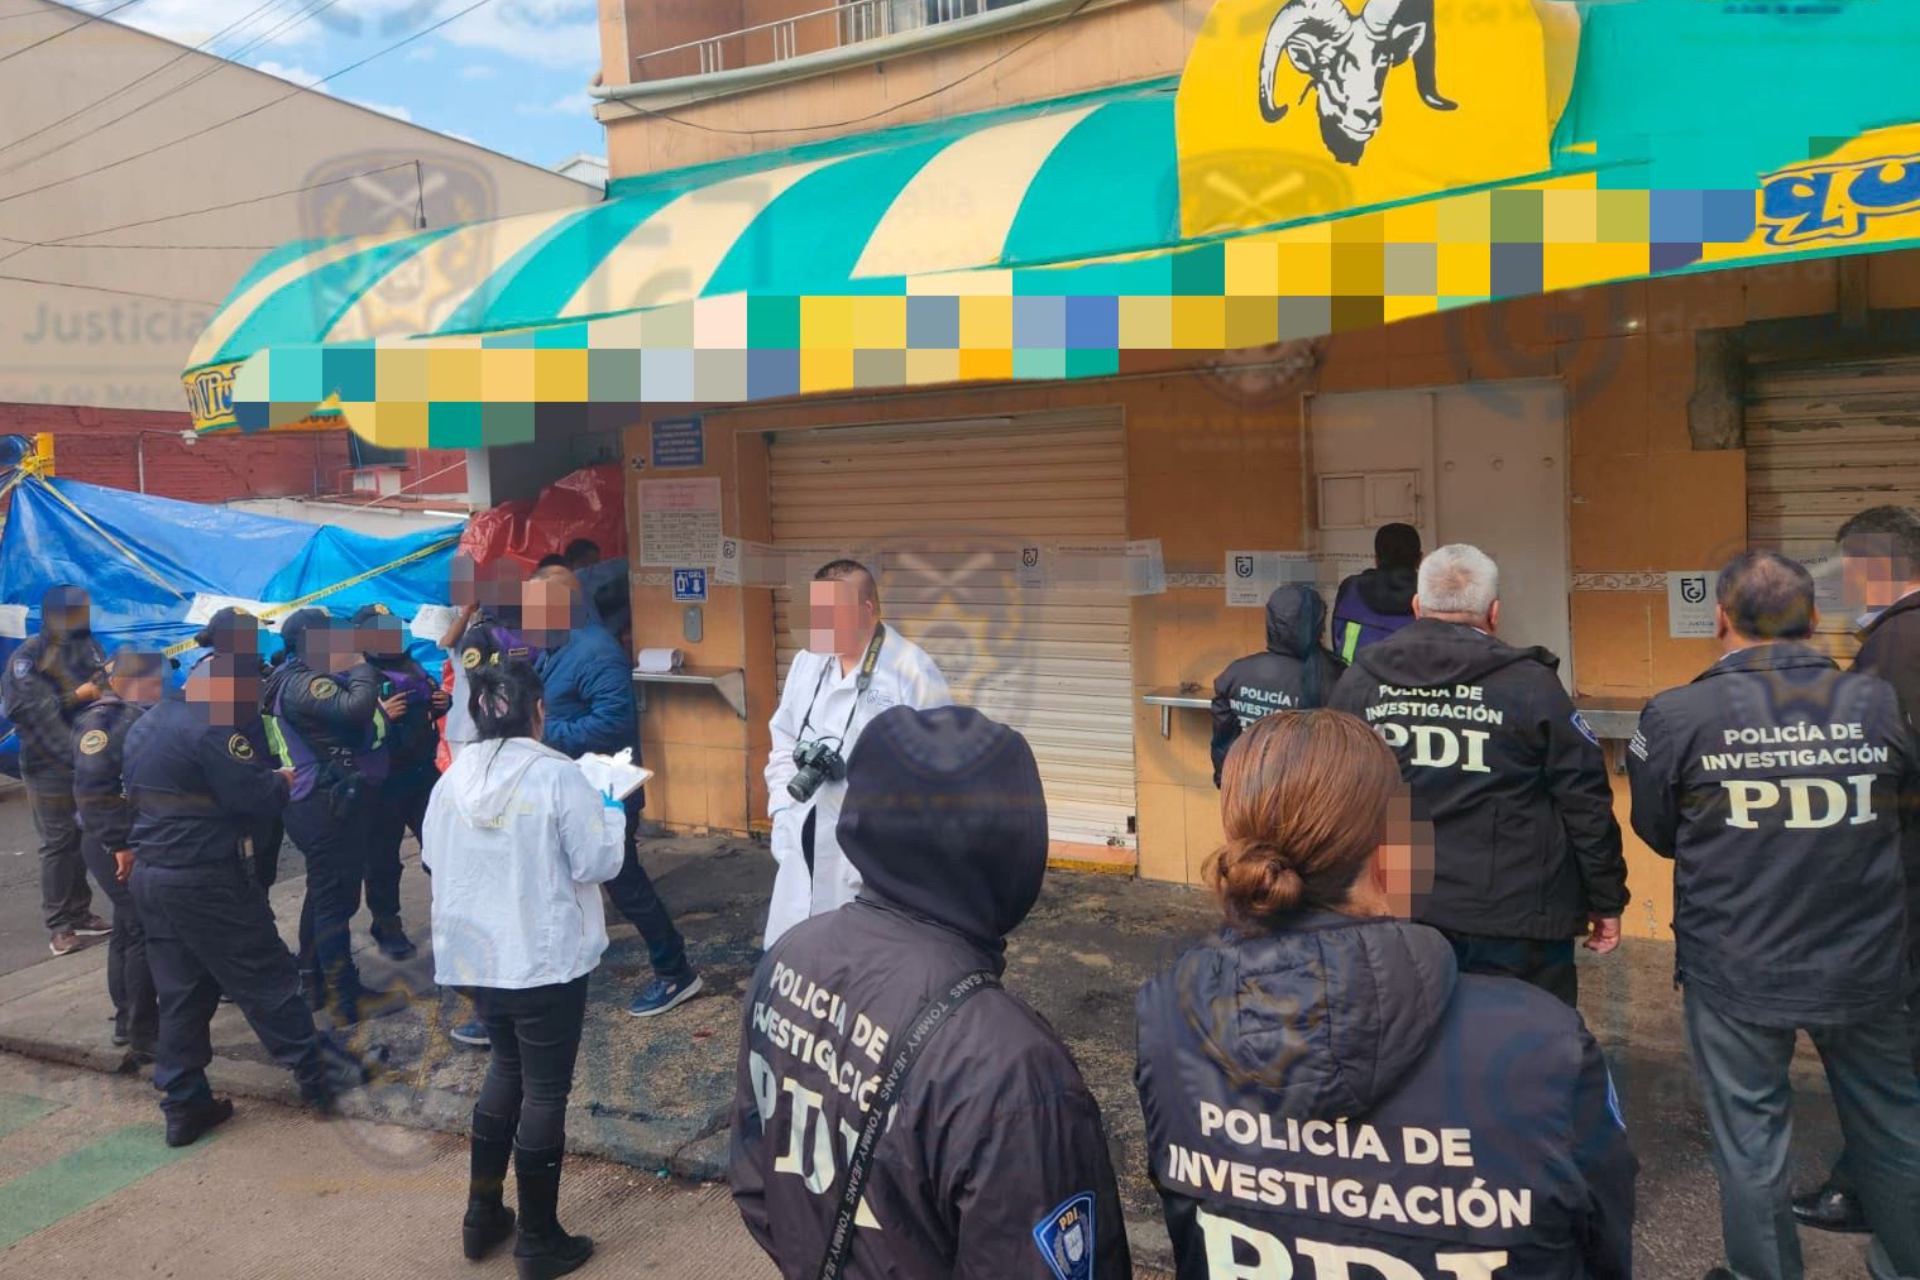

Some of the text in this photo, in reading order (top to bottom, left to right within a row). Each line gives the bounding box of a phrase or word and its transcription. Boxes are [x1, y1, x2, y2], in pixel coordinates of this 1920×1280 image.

[1240, 686, 1291, 707] POLICÍA
[1366, 702, 1503, 725] INVESTIGACIÓN
[1455, 684, 1483, 701] DE
[1724, 721, 1863, 745] POLICÍA DE
[1701, 743, 1888, 770] INVESTIGACIÓN
[1720, 774, 1877, 829] PDI
[851, 1013, 889, 1064] DE
[907, 1004, 949, 1052] TOMMY
[881, 1050, 908, 1101] JEANS
[860, 1109, 883, 1164] TOMMY
[1199, 1101, 1474, 1168] POLICÍA DE
[846, 1164, 866, 1205] JEANS
[1168, 1143, 1532, 1229] INVESTIGACIÓN
[830, 1211, 851, 1256] TOMMY
[1058, 1207, 1078, 1231] PDI
[821, 1255, 838, 1280] JEA
